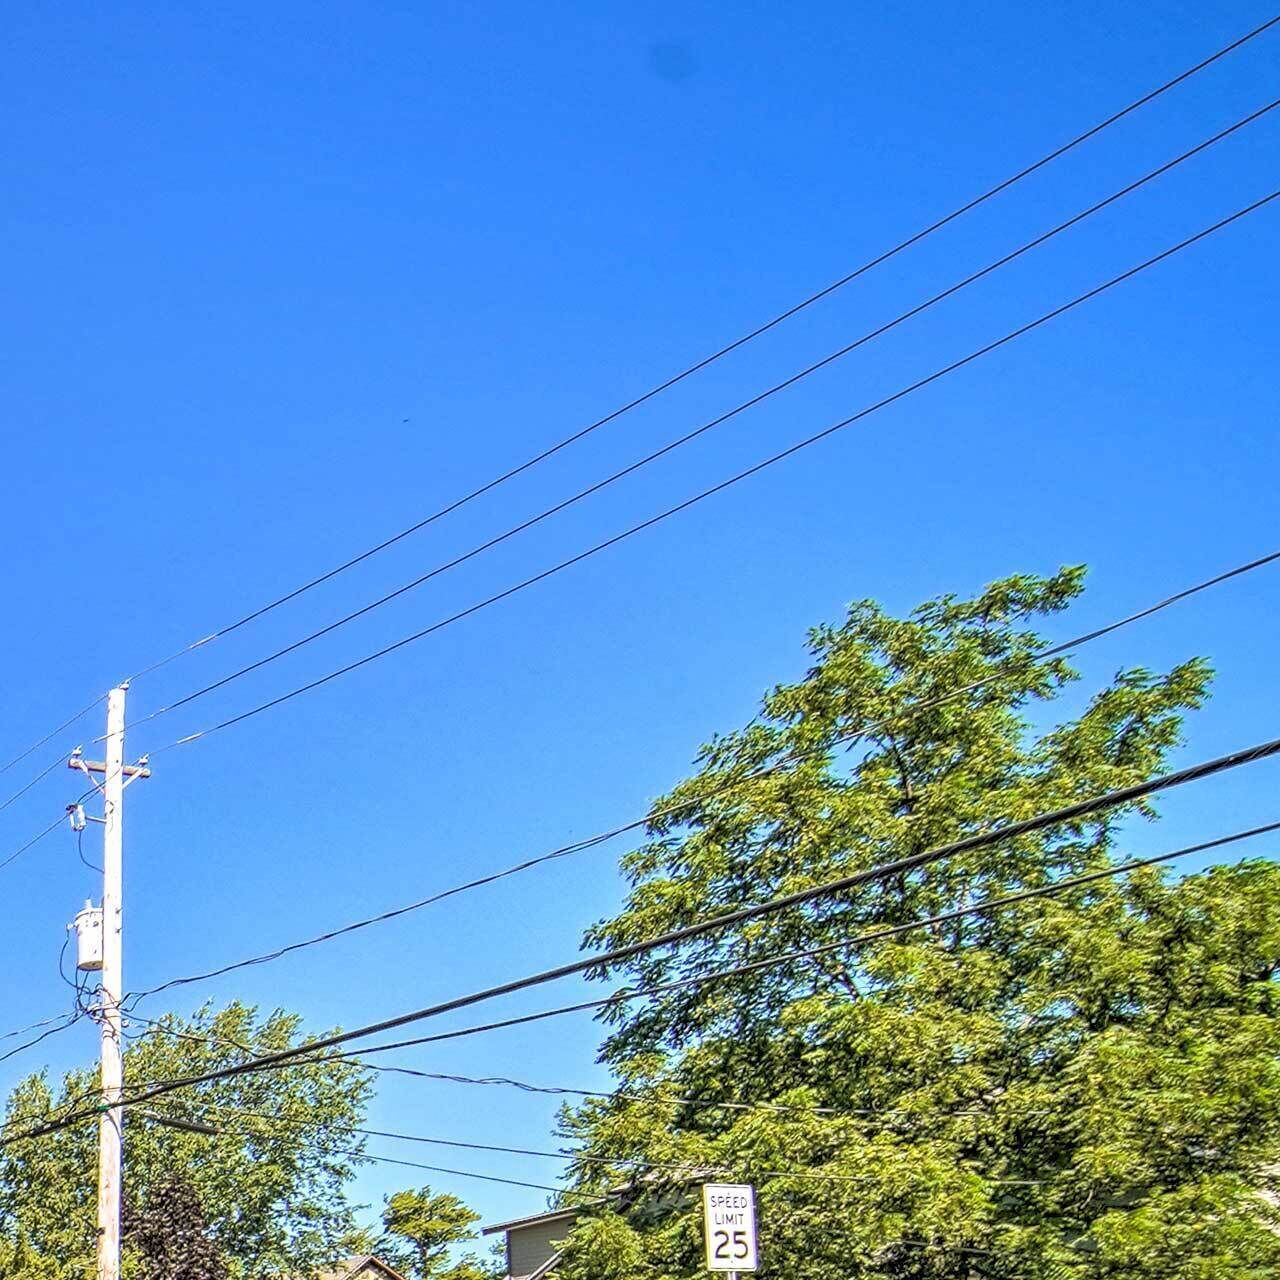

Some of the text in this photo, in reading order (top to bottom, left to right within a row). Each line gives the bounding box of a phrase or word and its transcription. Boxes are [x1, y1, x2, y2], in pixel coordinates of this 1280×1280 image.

[710, 1195, 748, 1209] SPEED
[715, 1213, 745, 1225] LIMIT
[713, 1230, 749, 1260] 25
